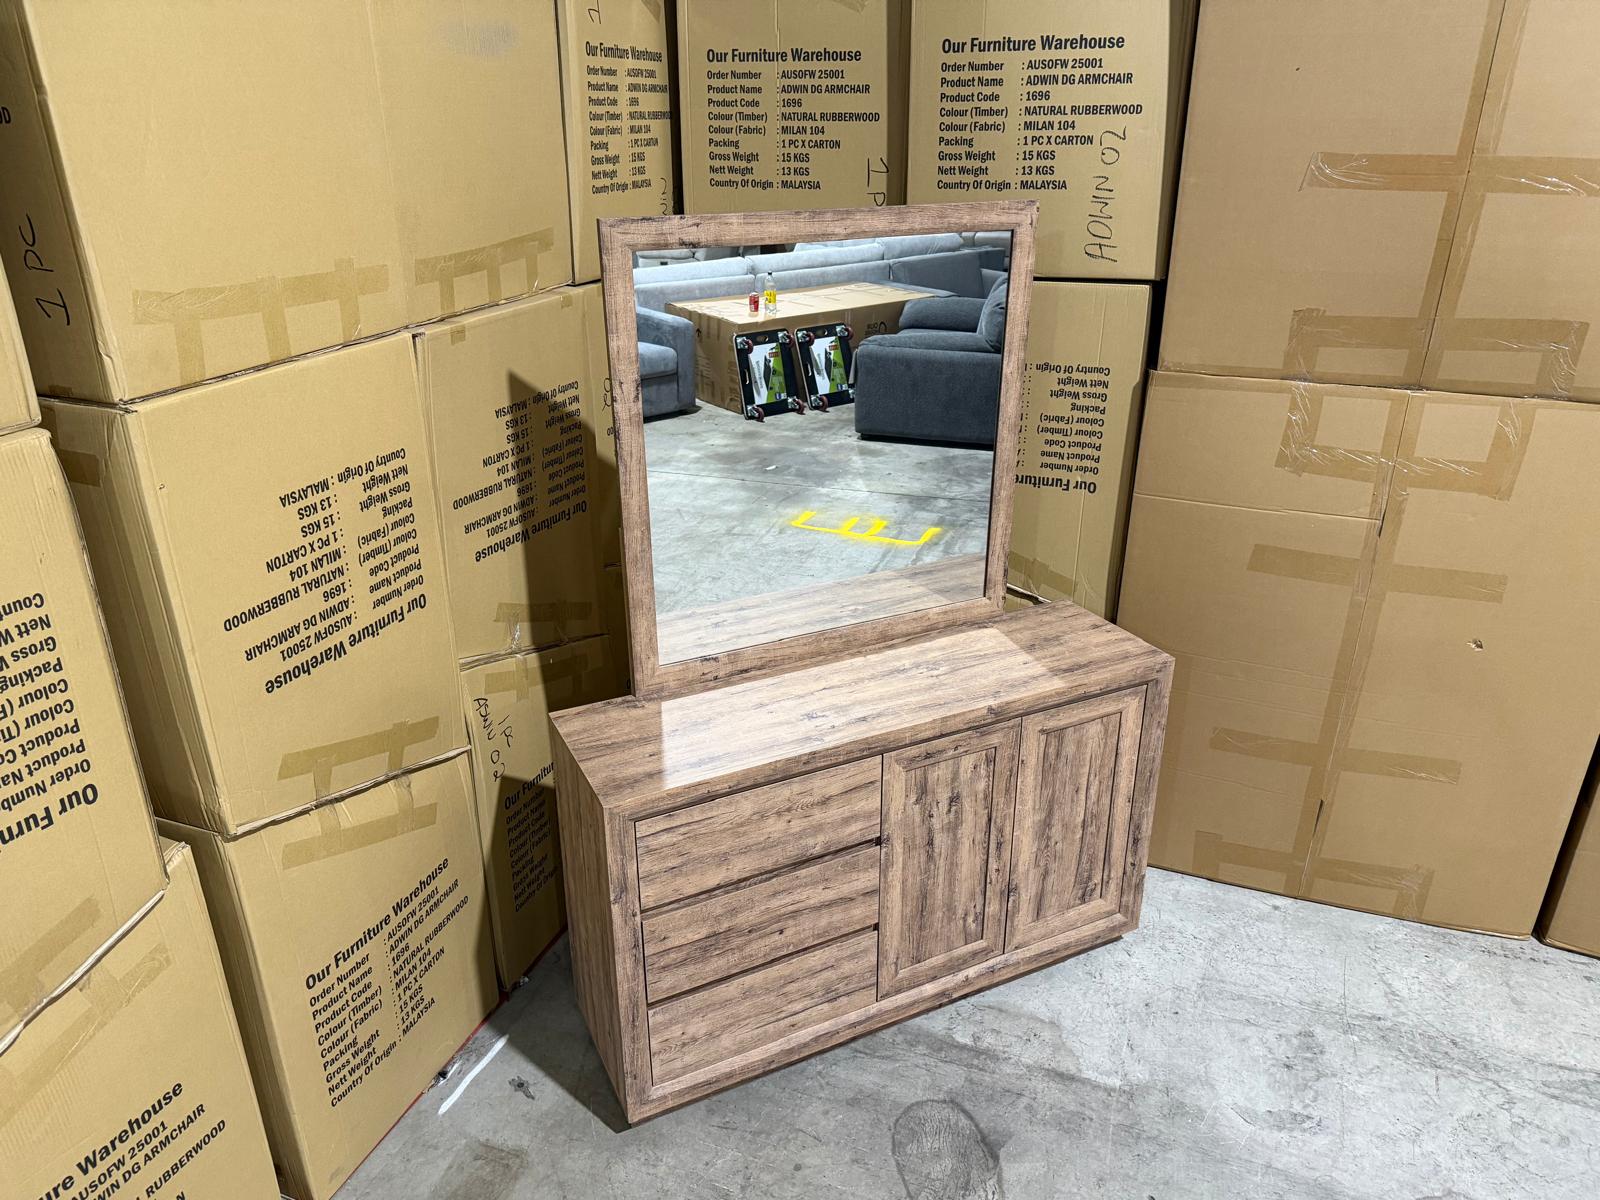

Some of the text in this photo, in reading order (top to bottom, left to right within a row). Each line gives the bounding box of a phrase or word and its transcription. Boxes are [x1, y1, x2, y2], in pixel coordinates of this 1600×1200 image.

[586, 41, 662, 62] Our Furniture Warehouse
[942, 34, 1125, 54] Our Furniture Warehouse
[707, 47, 862, 63] Our Furniture Warehouse
[941, 58, 1103, 72] Order Number AUSOFW 25001
[707, 69, 845, 80] Order Number AUSOFW 25001
[940, 72, 1133, 88] Product Name ADWIN DG ARMCHAIR
[707, 84, 870, 94] Product Name ADWIN DG ARMCHAIR
[940, 90, 1050, 103] Product Code 1696
[708, 111, 880, 124] Colour (Timber) NATURAL RUBBERWOOD
[940, 104, 1143, 119] Colour (Timber) NATURAL RUBBERWOOD
[708, 124, 825, 136] Colour (Fabric) MILAN 104
[939, 135, 1094, 148] Packing 1 PC X CARTON
[938, 150, 1056, 164] Gross Weight 15 KGS
[709, 165, 810, 177] Nett Weight 13 KGS
[709, 178, 821, 191] Country Of Origin MALAYSIA
[937, 179, 1067, 192] Country Of Origin MALAYSIA
[1036, 362, 1110, 377] Country Of Origin
[1050, 388, 1108, 403] Gross Weight
[494, 398, 528, 419] MALAYSIA
[1070, 402, 1106, 415] Packing
[1040, 412, 1105, 428] Colour (Fabric)
[482, 449, 510, 468] CARTON
[1040, 450, 1100, 464] Product Name
[279, 448, 406, 508] Country Of Origin MALAYSIA
[496, 463, 510, 477] 104
[1040, 462, 1099, 475] Order Number
[452, 481, 503, 510] RUBBERWOOD
[1073, 480, 1097, 494] Our
[300, 481, 410, 538] Gross Weight 15 KGS
[464, 505, 513, 534] DG ARMCHAIR
[474, 500, 587, 562] Our Furniture Warehouse
[486, 521, 507, 538] 25001
[224, 528, 417, 632] Colour (Timber) NATURAL RUBBERWOOD
[322, 543, 420, 603] Product Code 1696
[244, 558, 422, 661] Product Name ADWIN DG ARMCHAIR
[280, 574, 424, 662] Order Number AUSOFW 25001
[15, 614, 51, 638] Nett
[11, 636, 56, 662] Gross
[265, 593, 426, 694] Our Furniture Warehouse
[18, 679, 68, 708] Colour
[24, 699, 74, 730] Colour
[19, 718, 80, 756] Product
[25, 739, 85, 777] Product
[50, 759, 90, 786] Order
[59, 784, 98, 815] Our
[505, 789, 520, 809] Our
[306, 858, 448, 990] Our Furniture Warehouse
[310, 886, 439, 1007] Order Number AUSOFW 25001
[312, 878, 459, 1021] Product Name ADWIN DG ARMCHAIR
[318, 895, 468, 1046] Colour (Timber) NATURAL RUBBERWOOD
[331, 997, 435, 1107] Country Of Origin MALAYSIA
[76, 1082, 183, 1176] Warehouse
[144, 1103, 206, 1166] ARMCHAIR
[128, 1120, 168, 1160] 25001
[145, 1119, 226, 1198] RUBBERWOOD
